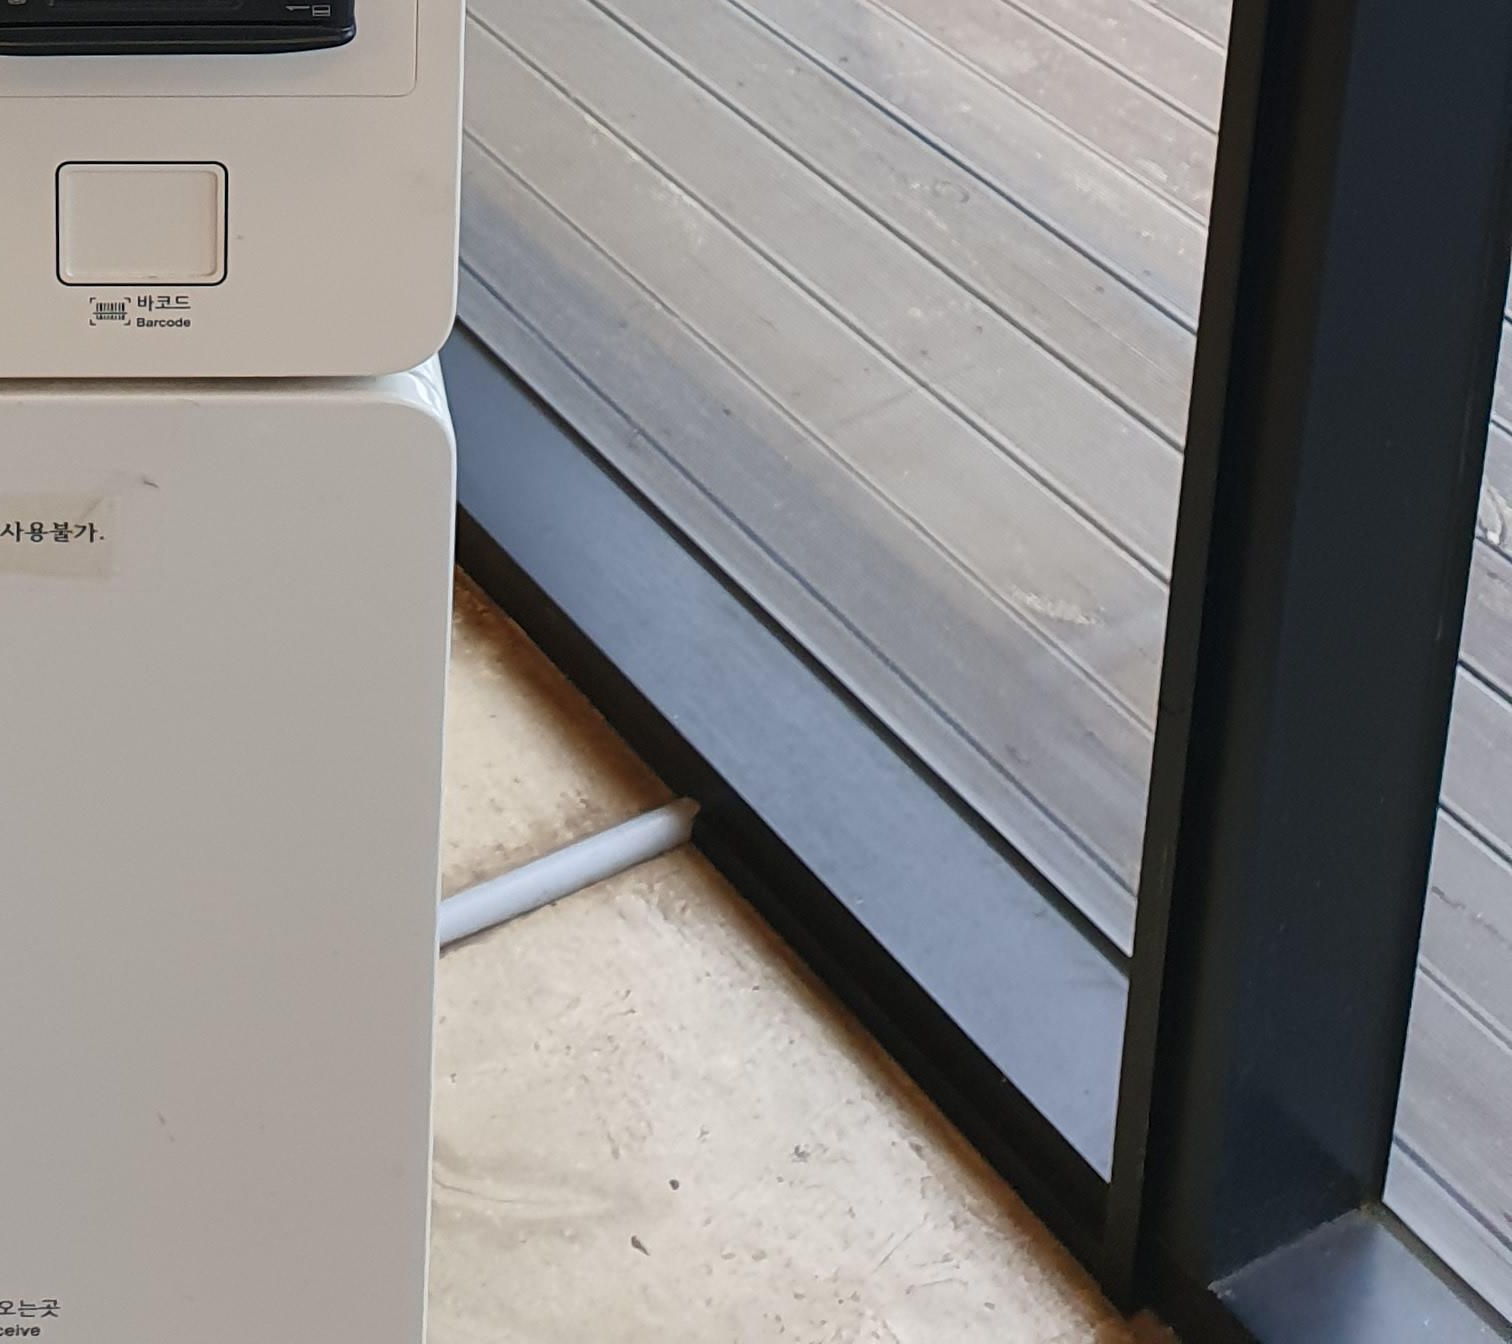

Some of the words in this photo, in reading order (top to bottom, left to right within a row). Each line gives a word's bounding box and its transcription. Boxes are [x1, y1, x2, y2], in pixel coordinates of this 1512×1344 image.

[138, 295, 191, 311] 바코드
[136, 317, 190, 327] Barcode
[0, 521, 104, 543] 사용불가.
